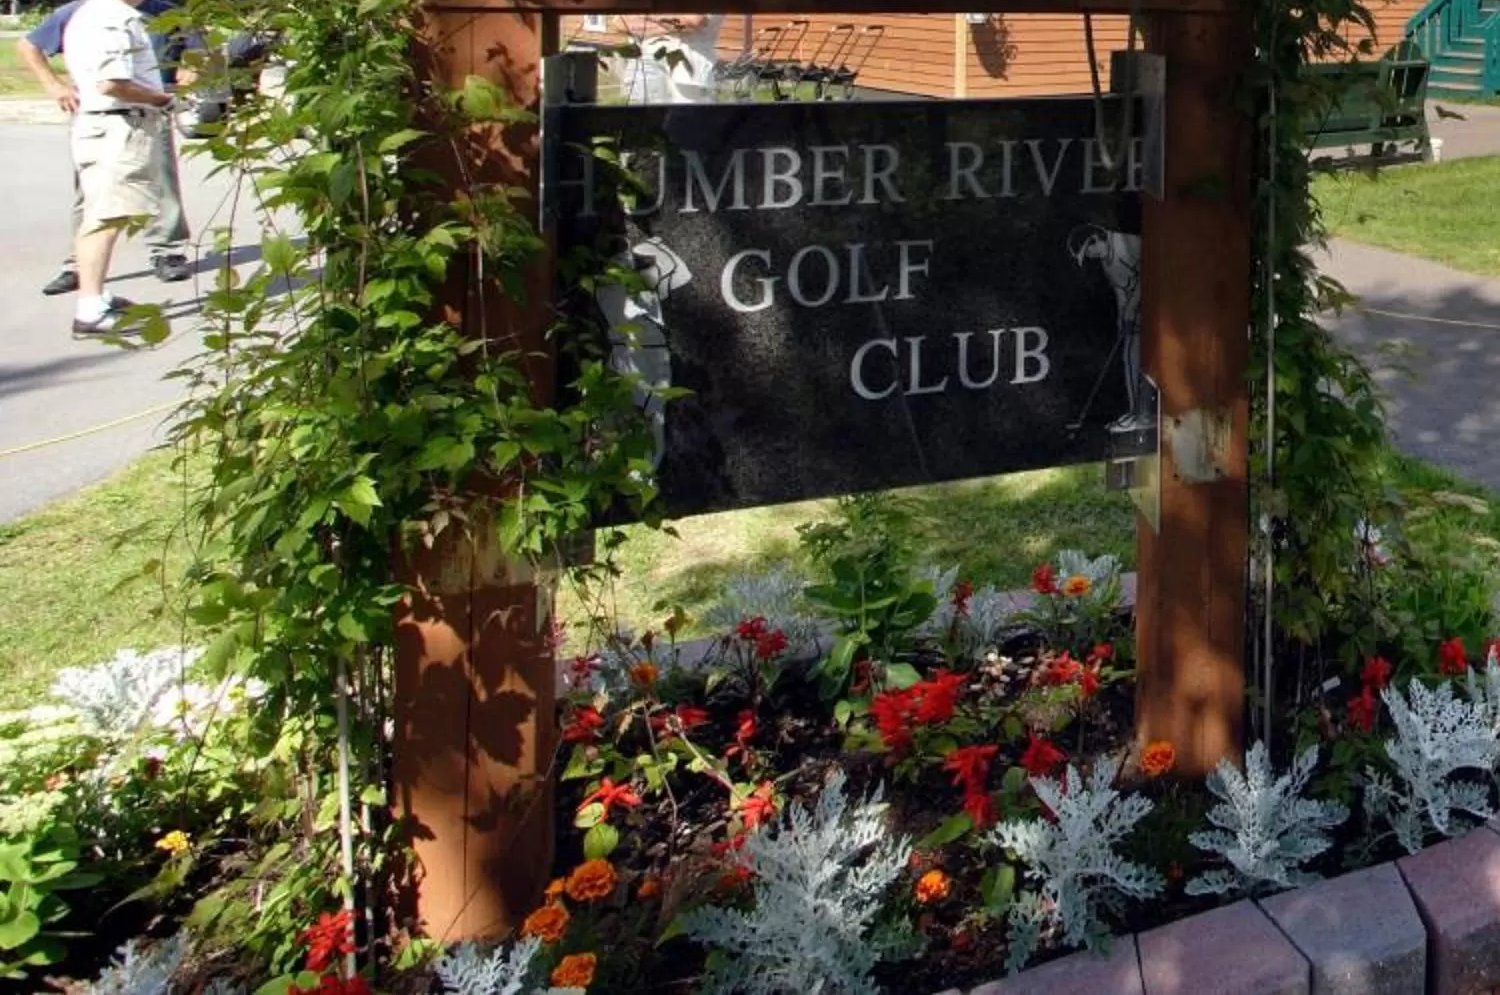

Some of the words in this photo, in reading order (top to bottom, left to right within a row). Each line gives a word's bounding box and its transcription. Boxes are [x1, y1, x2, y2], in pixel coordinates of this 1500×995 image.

[558, 143, 905, 217] HUMBER
[720, 239, 934, 313] GOLF
[850, 326, 1050, 401] CLUB
